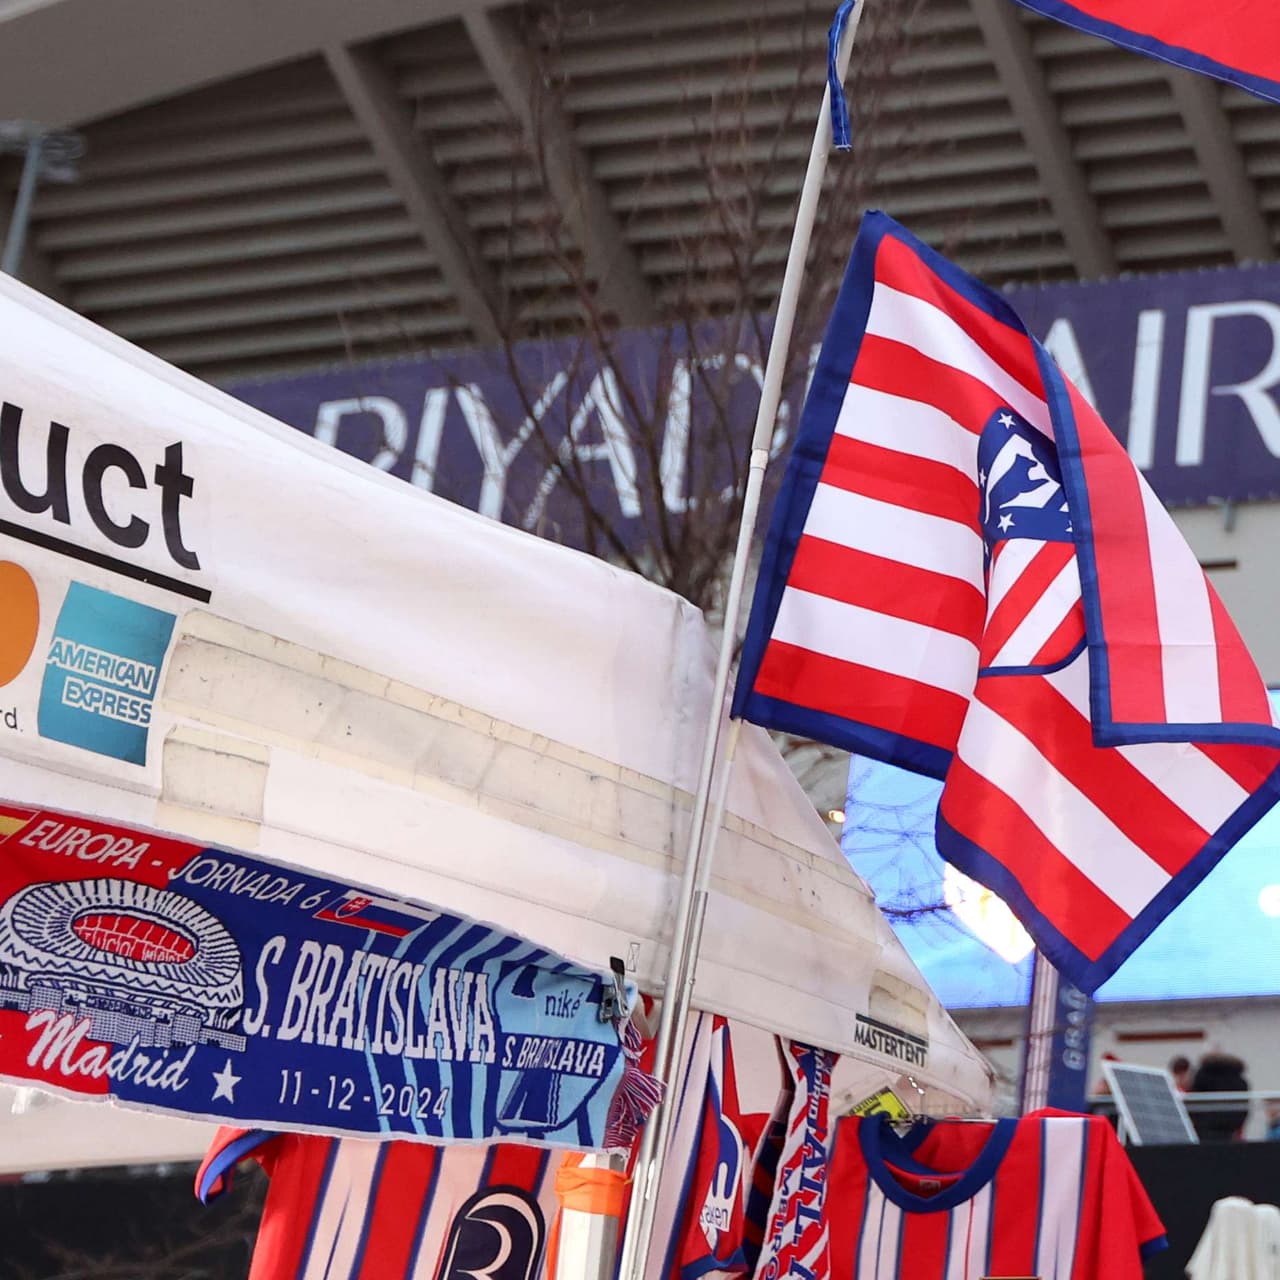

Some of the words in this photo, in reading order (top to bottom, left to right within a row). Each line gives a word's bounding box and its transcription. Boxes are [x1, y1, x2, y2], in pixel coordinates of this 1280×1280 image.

[0, 401, 201, 570] uct
[47, 637, 157, 694] AMERICAN
[62, 677, 153, 727] EXPRESS
[19, 820, 152, 869] EUROPA
[168, 856, 305, 905] JORNADA
[299, 890, 331, 909] 6
[276, 940, 496, 1063] BRATISLAVA
[25, 1010, 197, 1091] Madrid
[854, 1023, 928, 1067] MASTERTENT
